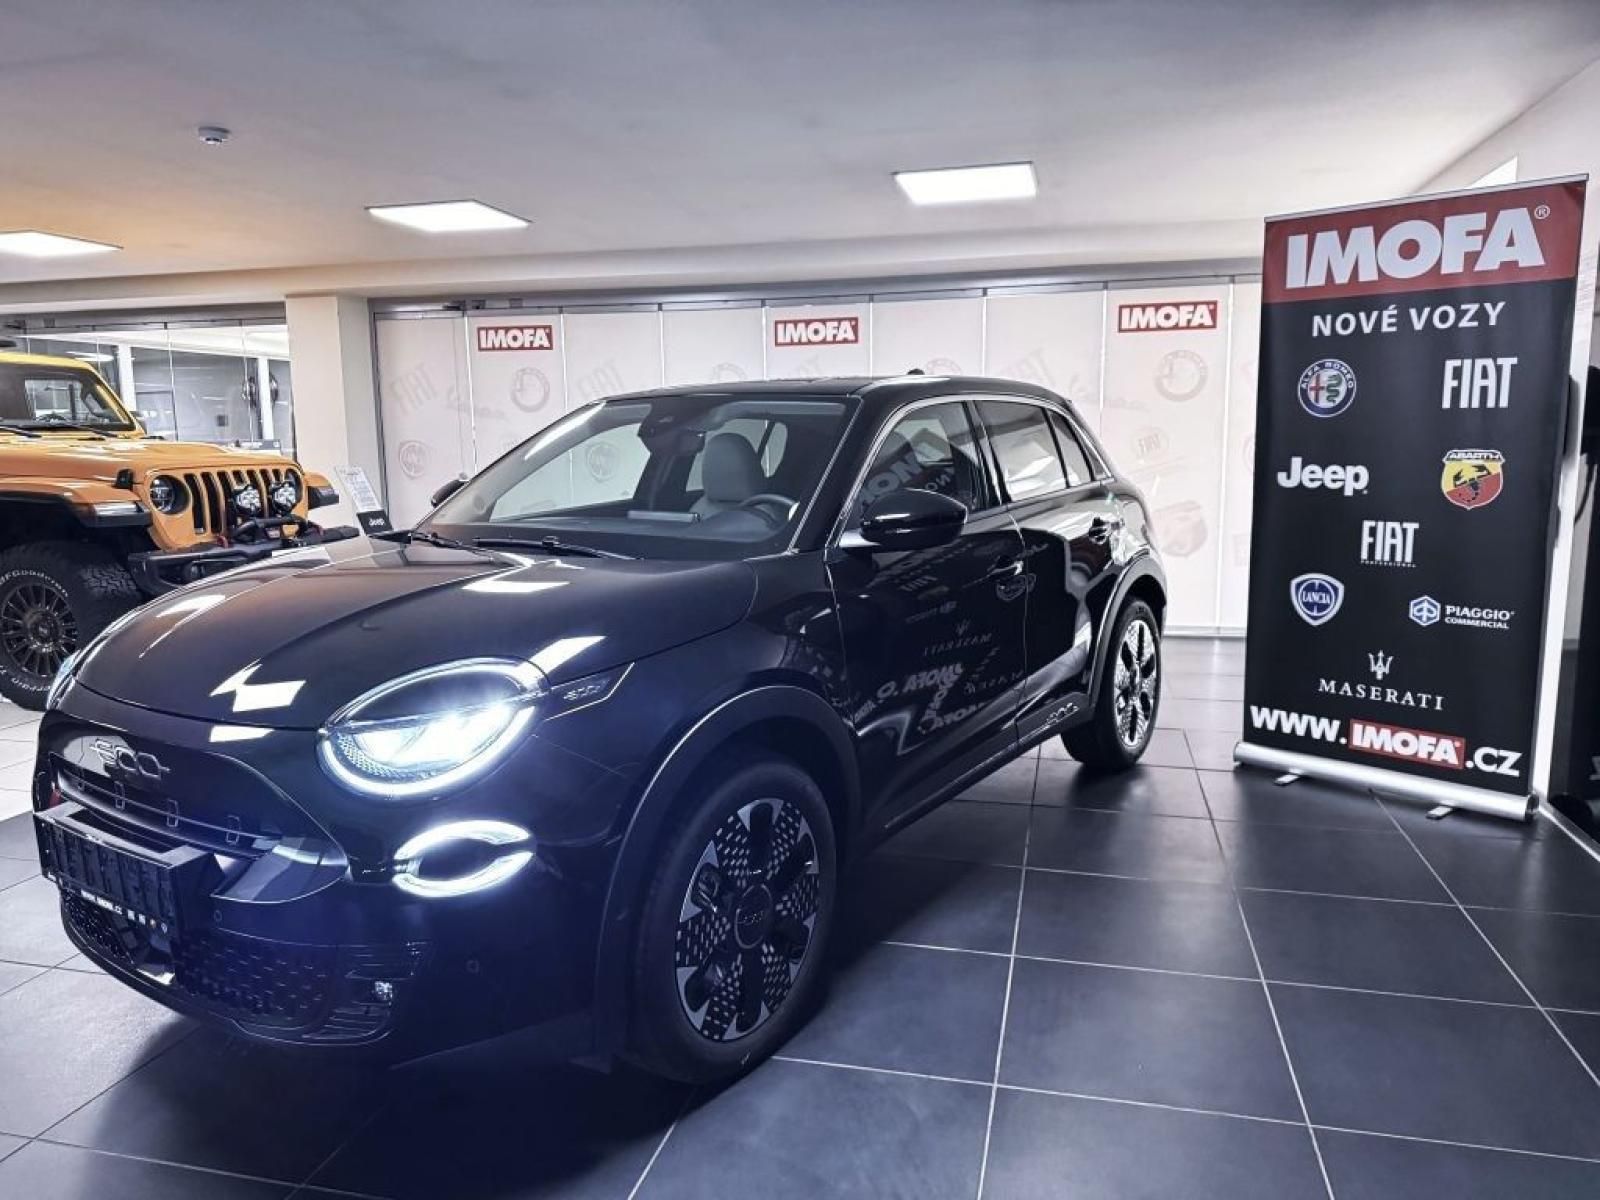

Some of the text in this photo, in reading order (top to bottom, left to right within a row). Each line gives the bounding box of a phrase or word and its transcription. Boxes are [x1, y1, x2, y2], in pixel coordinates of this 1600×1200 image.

[777, 319, 856, 344] IMOFA
[1121, 303, 1214, 331] IMOFA
[1312, 301, 1506, 338] NOVÉ VOZY
[479, 327, 550, 349] IMOFA
[1442, 357, 1518, 409] FIAT
[1277, 456, 1369, 496] Jeep
[1360, 519, 1420, 563] FIAT
[1444, 616, 1510, 630] COMMERCIAL
[1318, 678, 1445, 711] MASERATI
